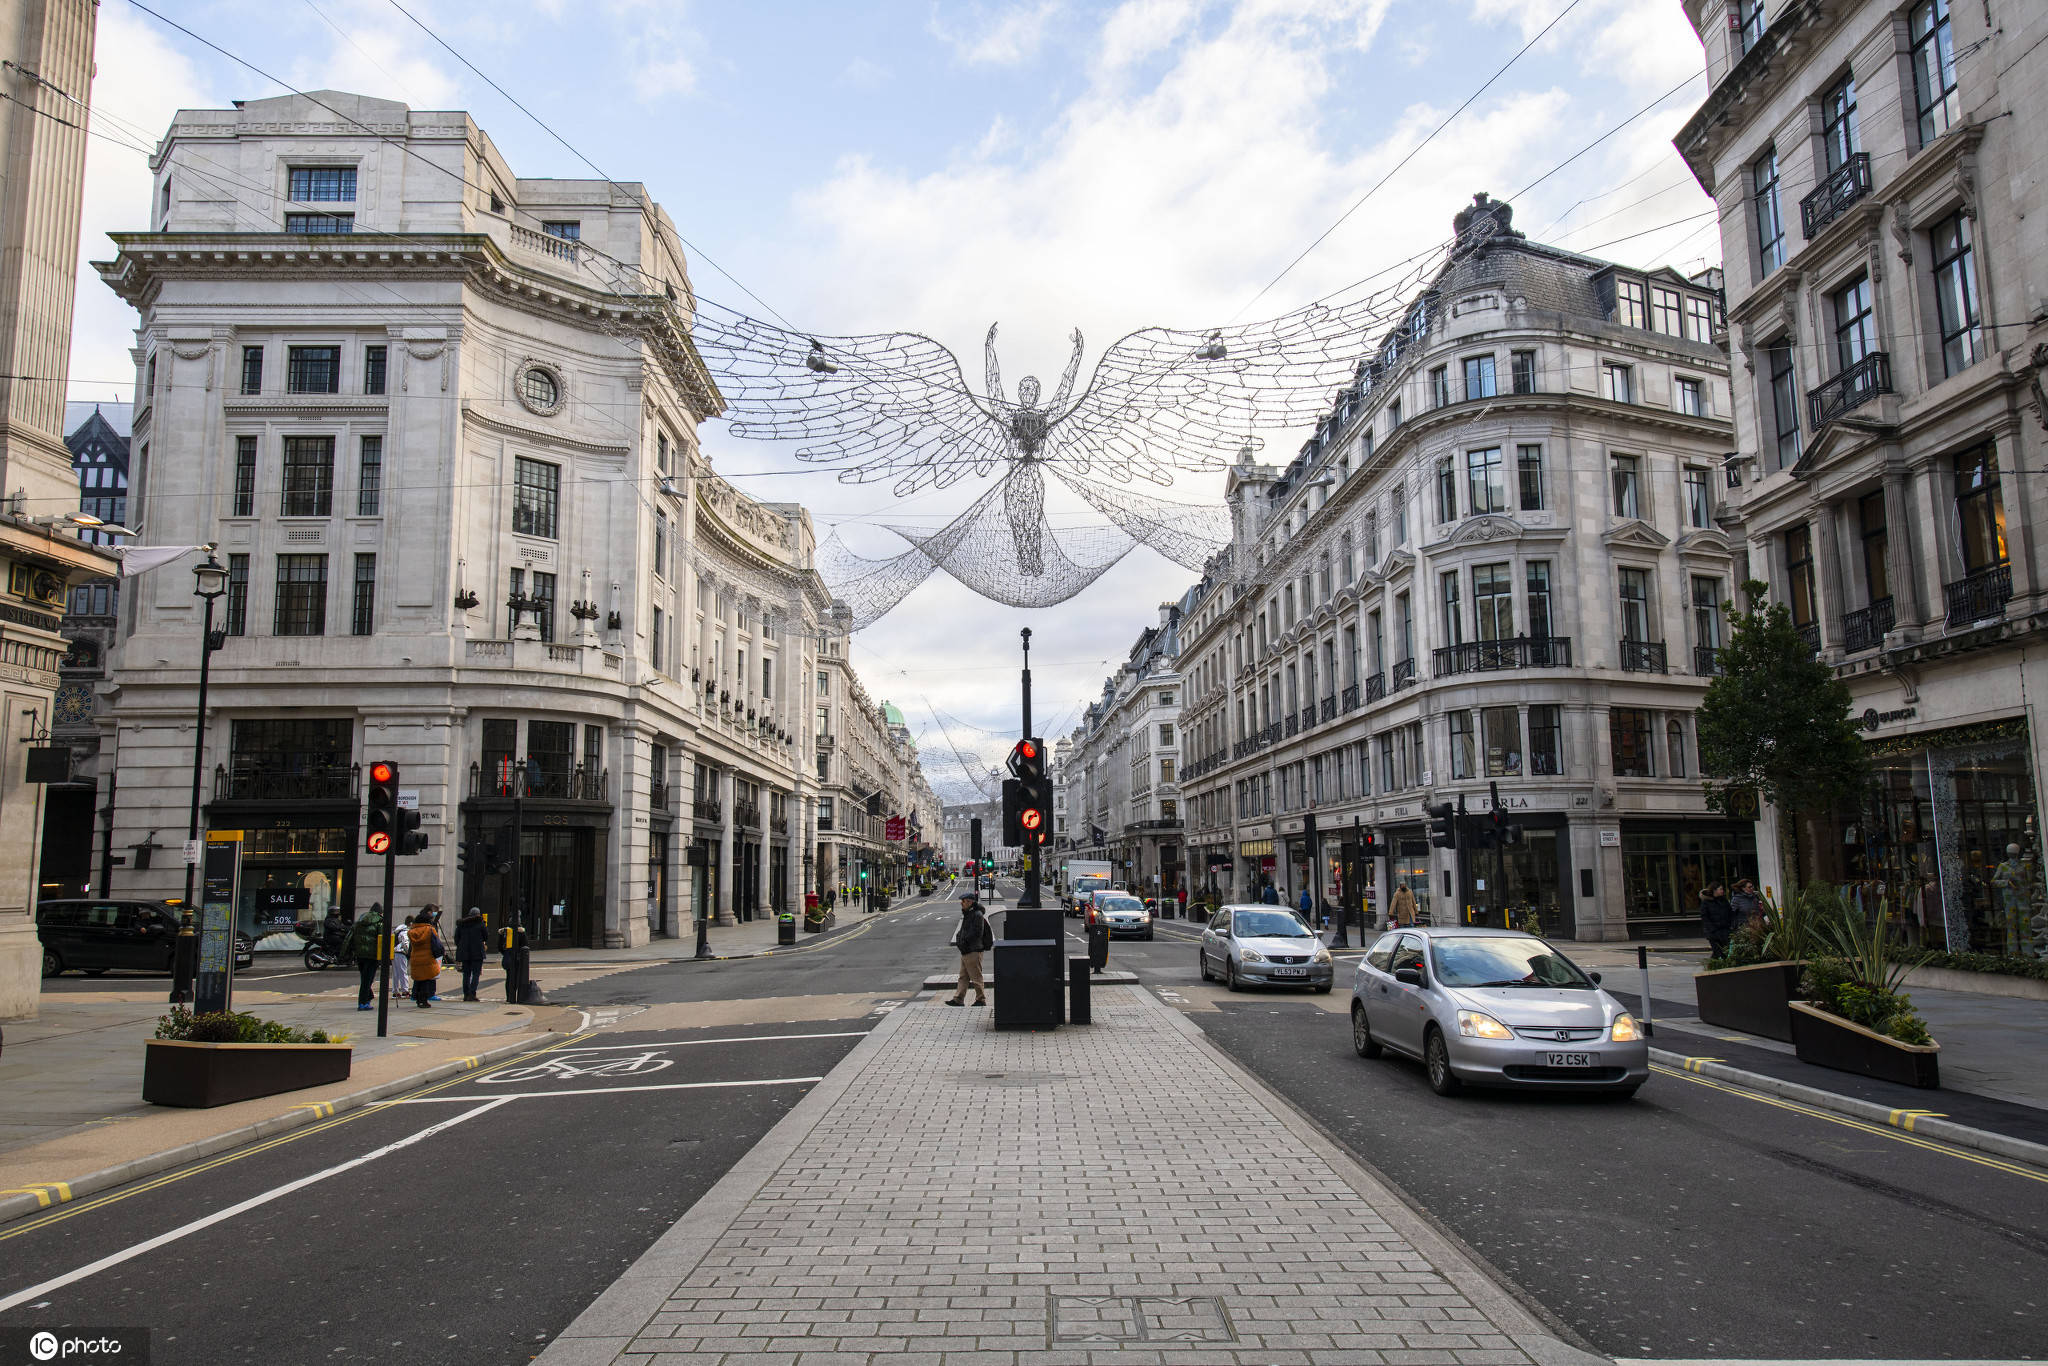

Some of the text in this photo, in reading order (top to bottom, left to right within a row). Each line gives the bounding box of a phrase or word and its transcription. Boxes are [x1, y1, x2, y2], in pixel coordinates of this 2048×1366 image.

[1879, 707, 1916, 723] BURCH
[1482, 797, 1528, 809] FRLA
[270, 894, 295, 903] SALE
[274, 916, 292, 925] 50%
[1548, 1053, 1589, 1066] V2 CSK
